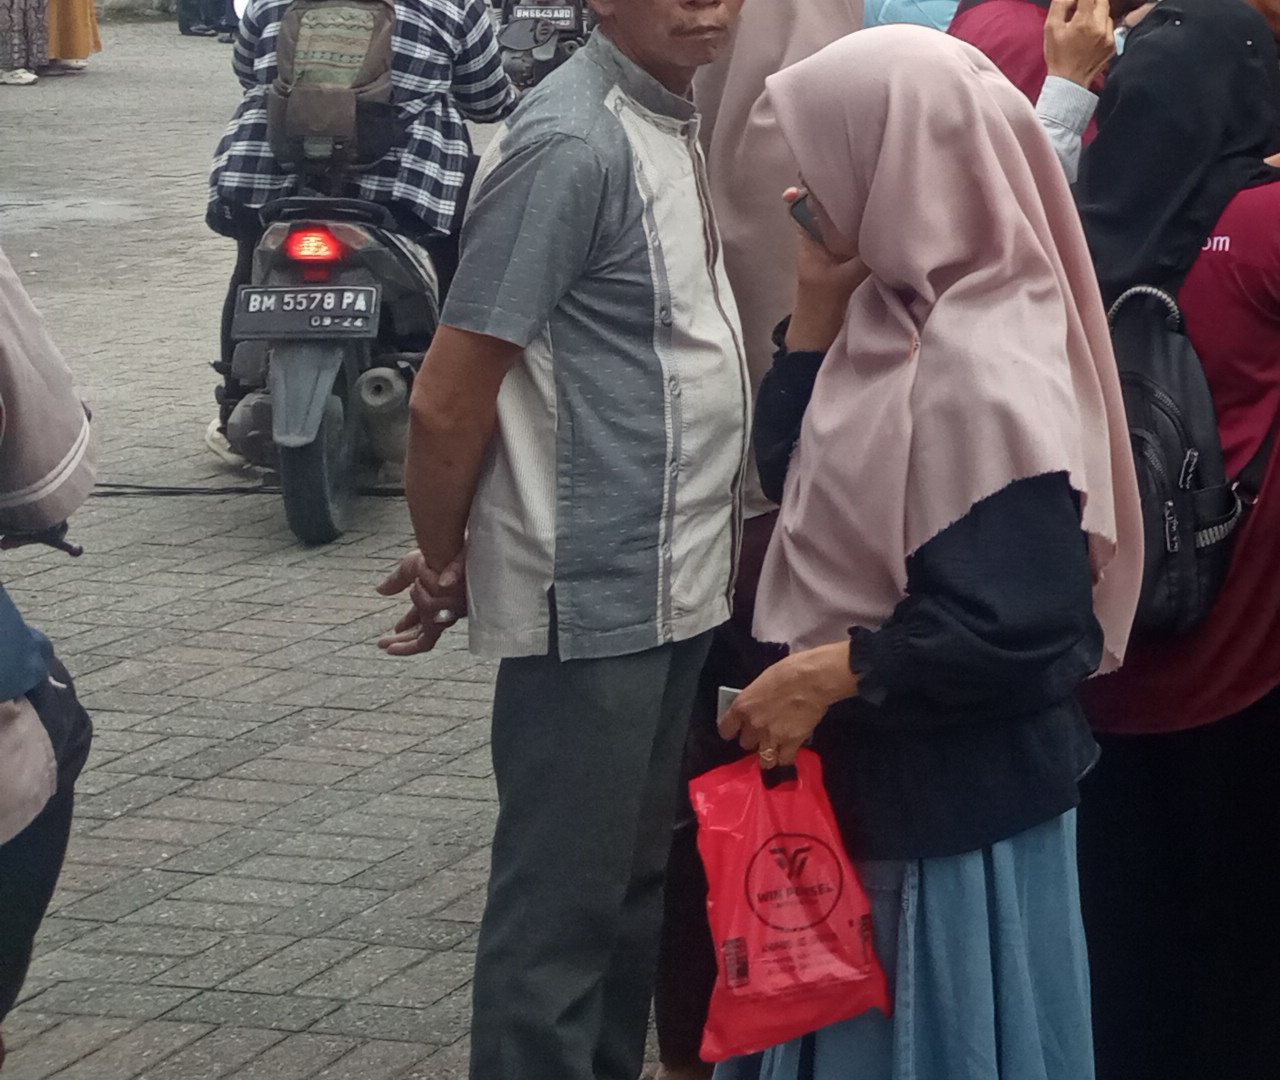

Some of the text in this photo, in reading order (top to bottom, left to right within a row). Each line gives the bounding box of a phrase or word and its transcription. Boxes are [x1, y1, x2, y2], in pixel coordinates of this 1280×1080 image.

[248, 291, 367, 313] BM 5578 PA
